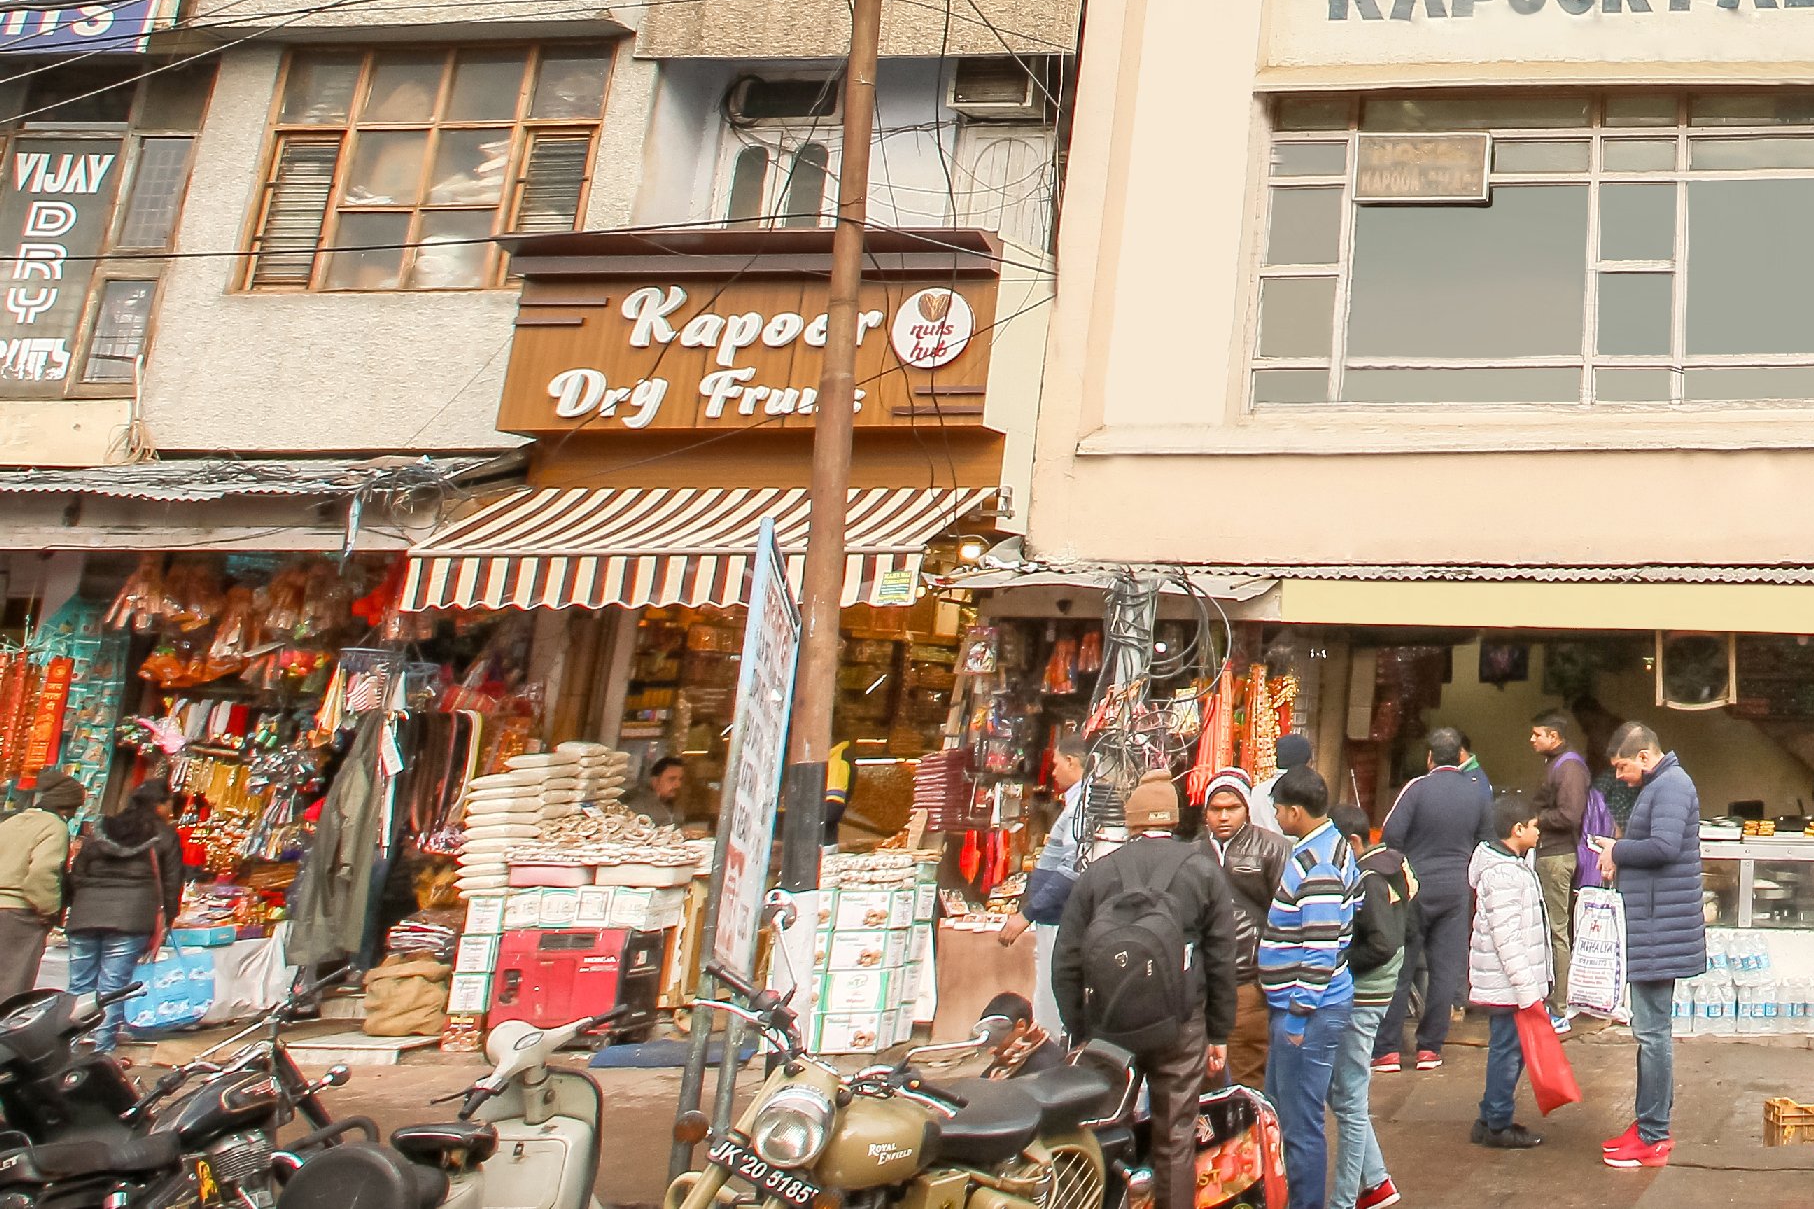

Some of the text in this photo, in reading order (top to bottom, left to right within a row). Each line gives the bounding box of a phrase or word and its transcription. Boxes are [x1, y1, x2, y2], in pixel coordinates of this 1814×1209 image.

[14, 153, 116, 194] VIJAY
[547, 368, 668, 429] Dry
[709, 1140, 743, 1166] JK
[867, 1142, 897, 1157] ROYAL
[877, 1147, 913, 1166] ENFIELD
